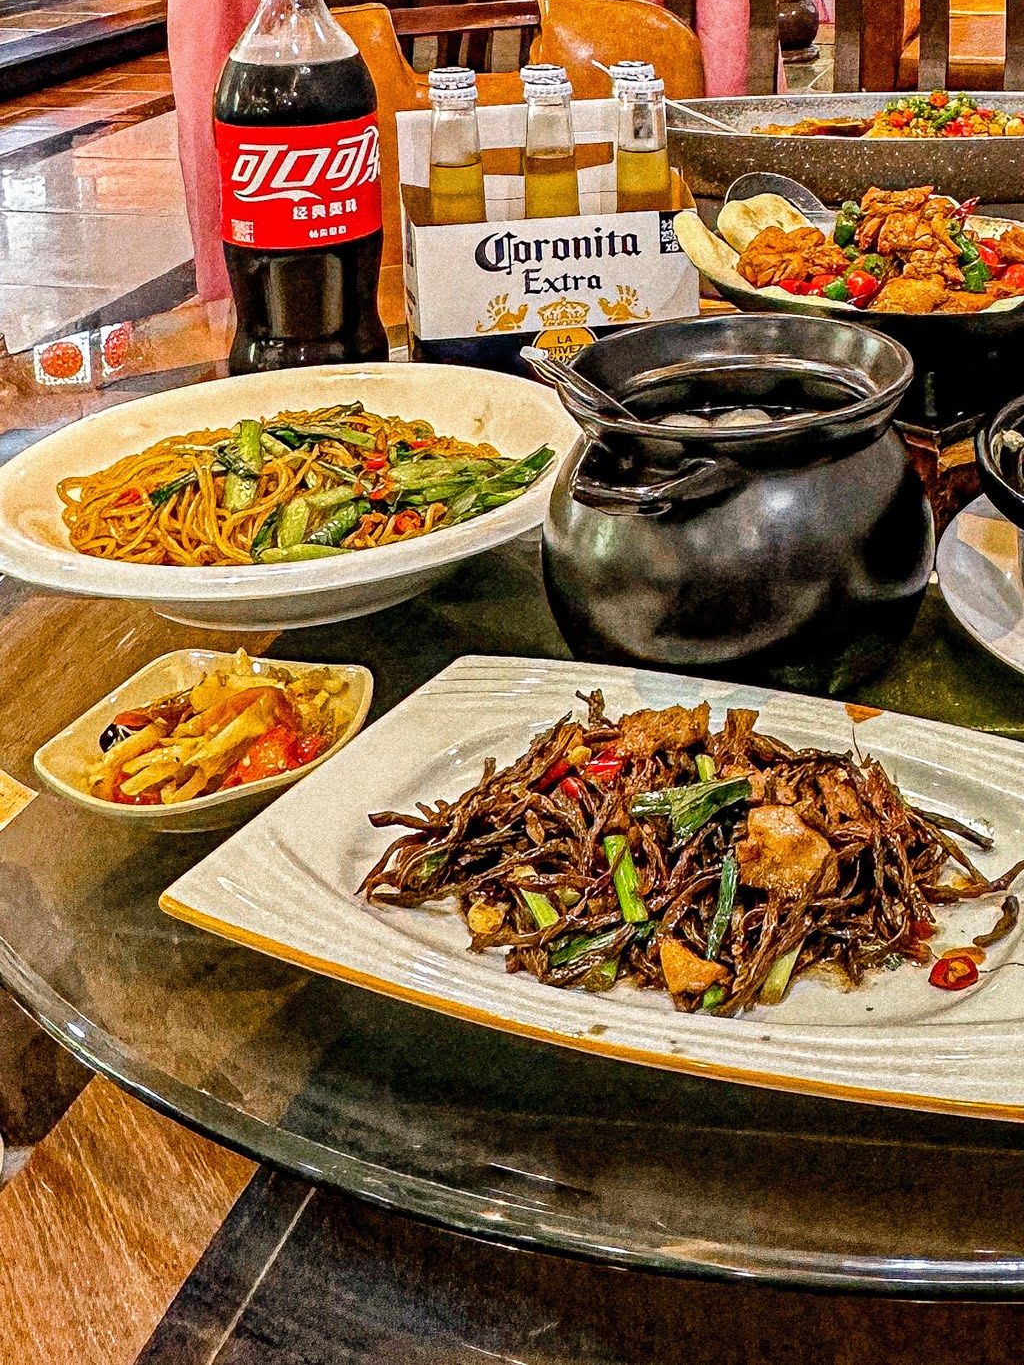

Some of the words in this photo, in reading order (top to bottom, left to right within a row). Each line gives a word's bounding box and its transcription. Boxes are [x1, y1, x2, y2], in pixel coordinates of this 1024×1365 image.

[475, 227, 642, 274] Coronita
[521, 268, 602, 295] Extra
[557, 335, 573, 344] LA
